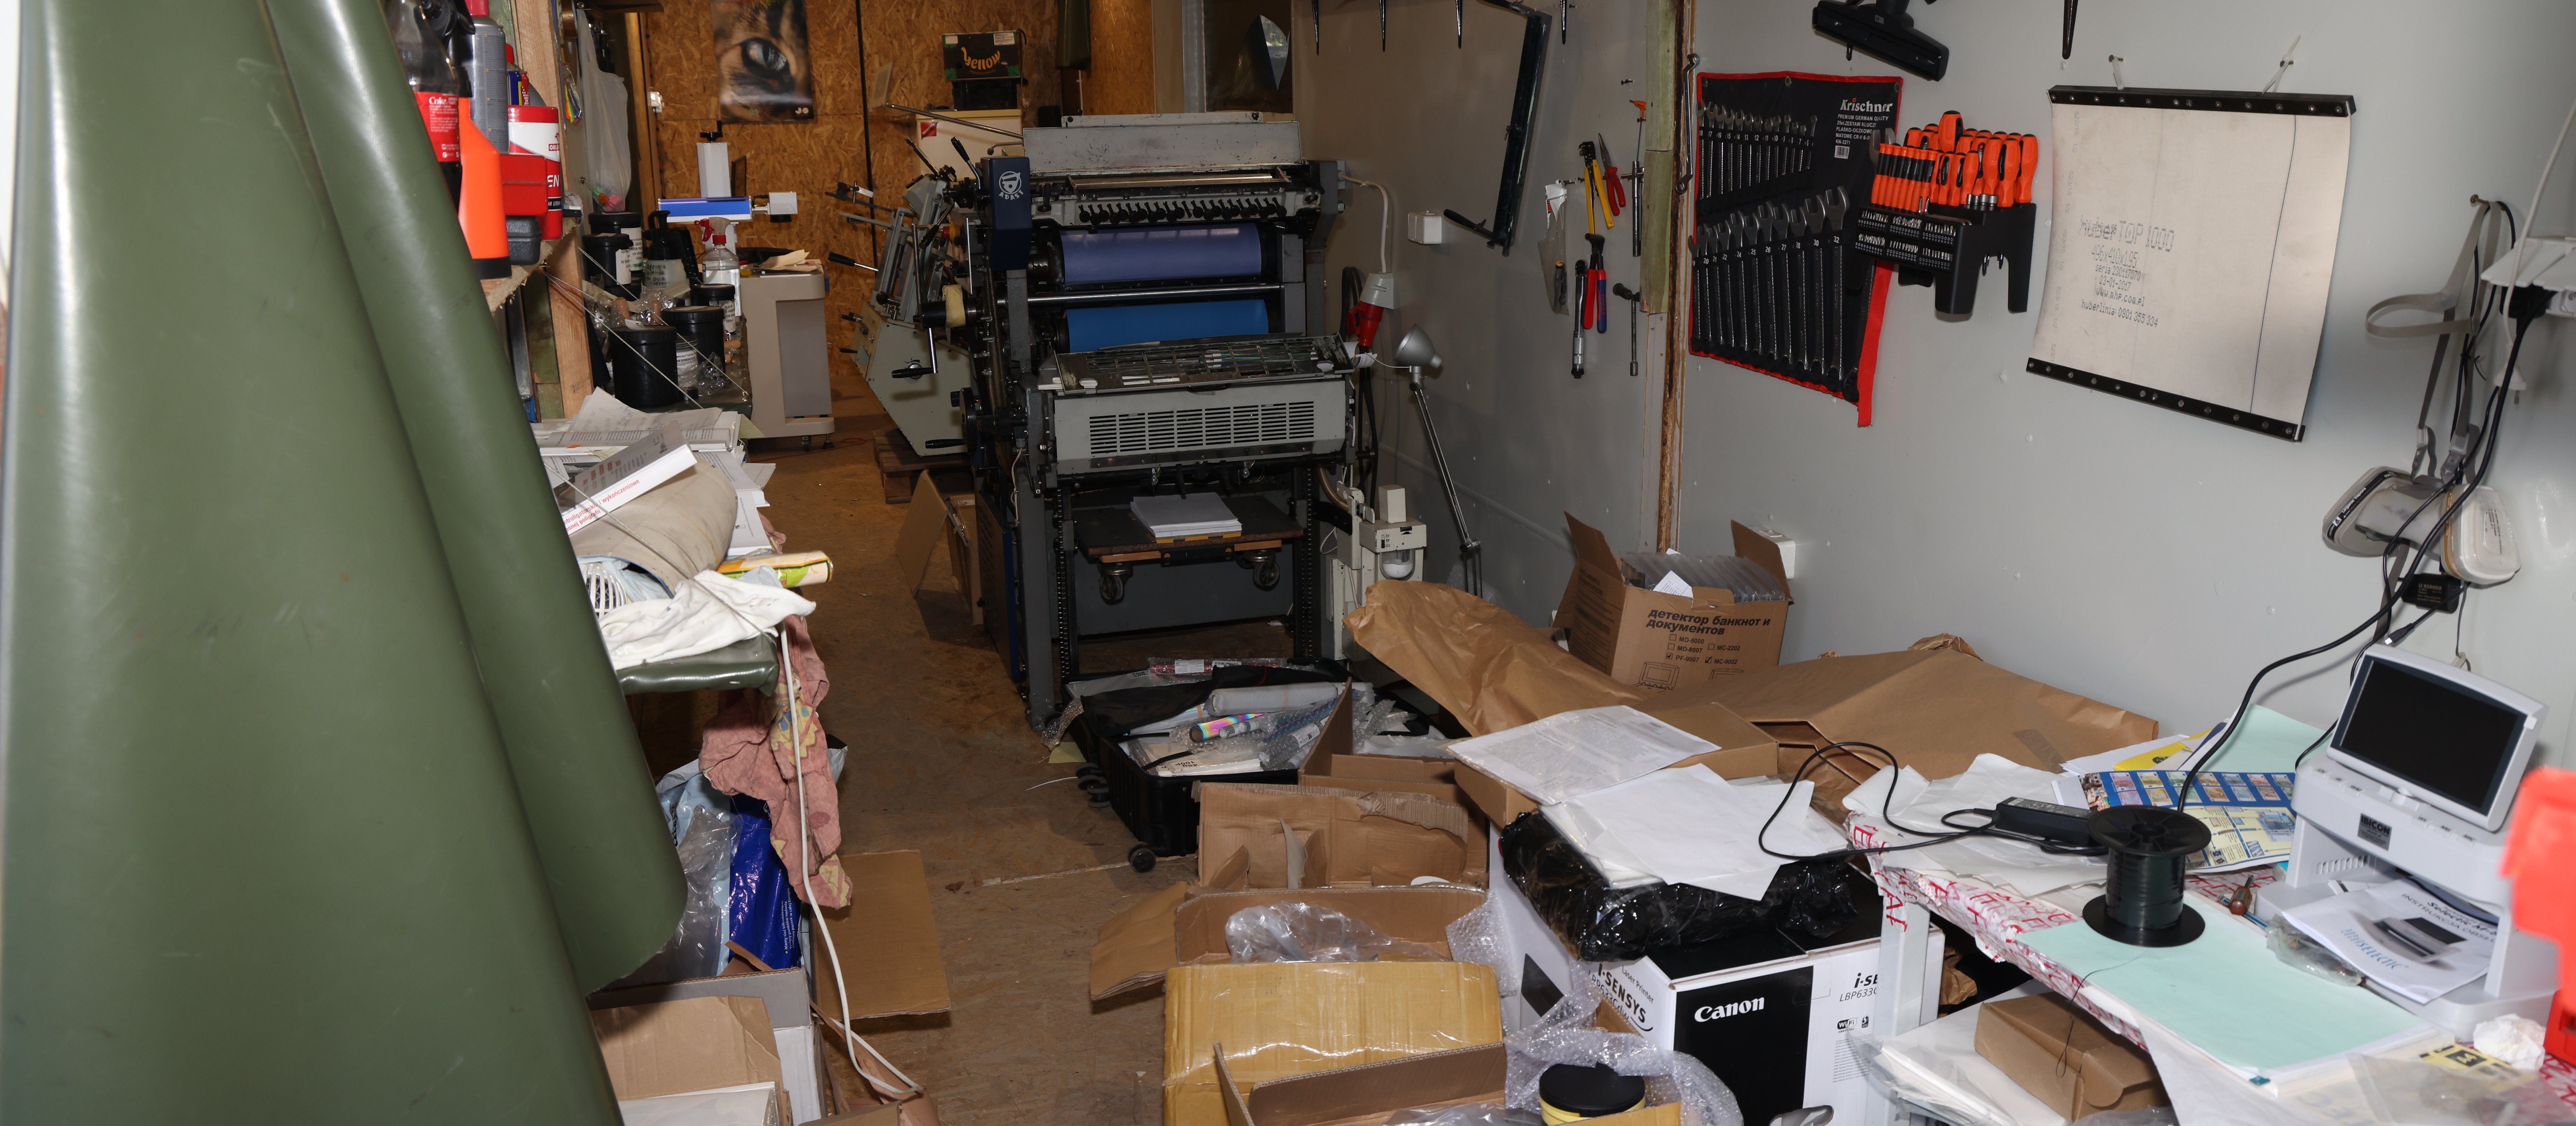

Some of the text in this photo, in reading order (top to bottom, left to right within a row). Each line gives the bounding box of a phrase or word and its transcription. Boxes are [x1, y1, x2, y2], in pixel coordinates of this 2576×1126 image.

[428, 96, 447, 105] Coke
[1840, 98, 1893, 112] Krischner
[998, 189, 1024, 200] ADAST
[2145, 226, 2175, 252] 1000
[2095, 264, 2111, 274] seria
[2099, 275, 2132, 291] 23-01-2017
[2096, 288, 2145, 306] www.mhp.com.pl
[2118, 307, 2132, 320] 0801
[2133, 311, 2146, 324] 355
[2147, 315, 2158, 328] 334
[601, 479, 640, 503] wykończeniowe
[2342, 487, 2367, 514] Organic Vapors
[579, 510, 601, 525] poligrafii
[1648, 609, 1709, 626] детектор
[1712, 616, 1761, 626] банкнот
[1645, 619, 1725, 635] документов
[2360, 815, 2391, 836] IBICON
[2402, 894, 2460, 930] INSTRUKCJA
[1622, 965, 1654, 1004] Laser Printer
[1694, 997, 1765, 1023] Canon
